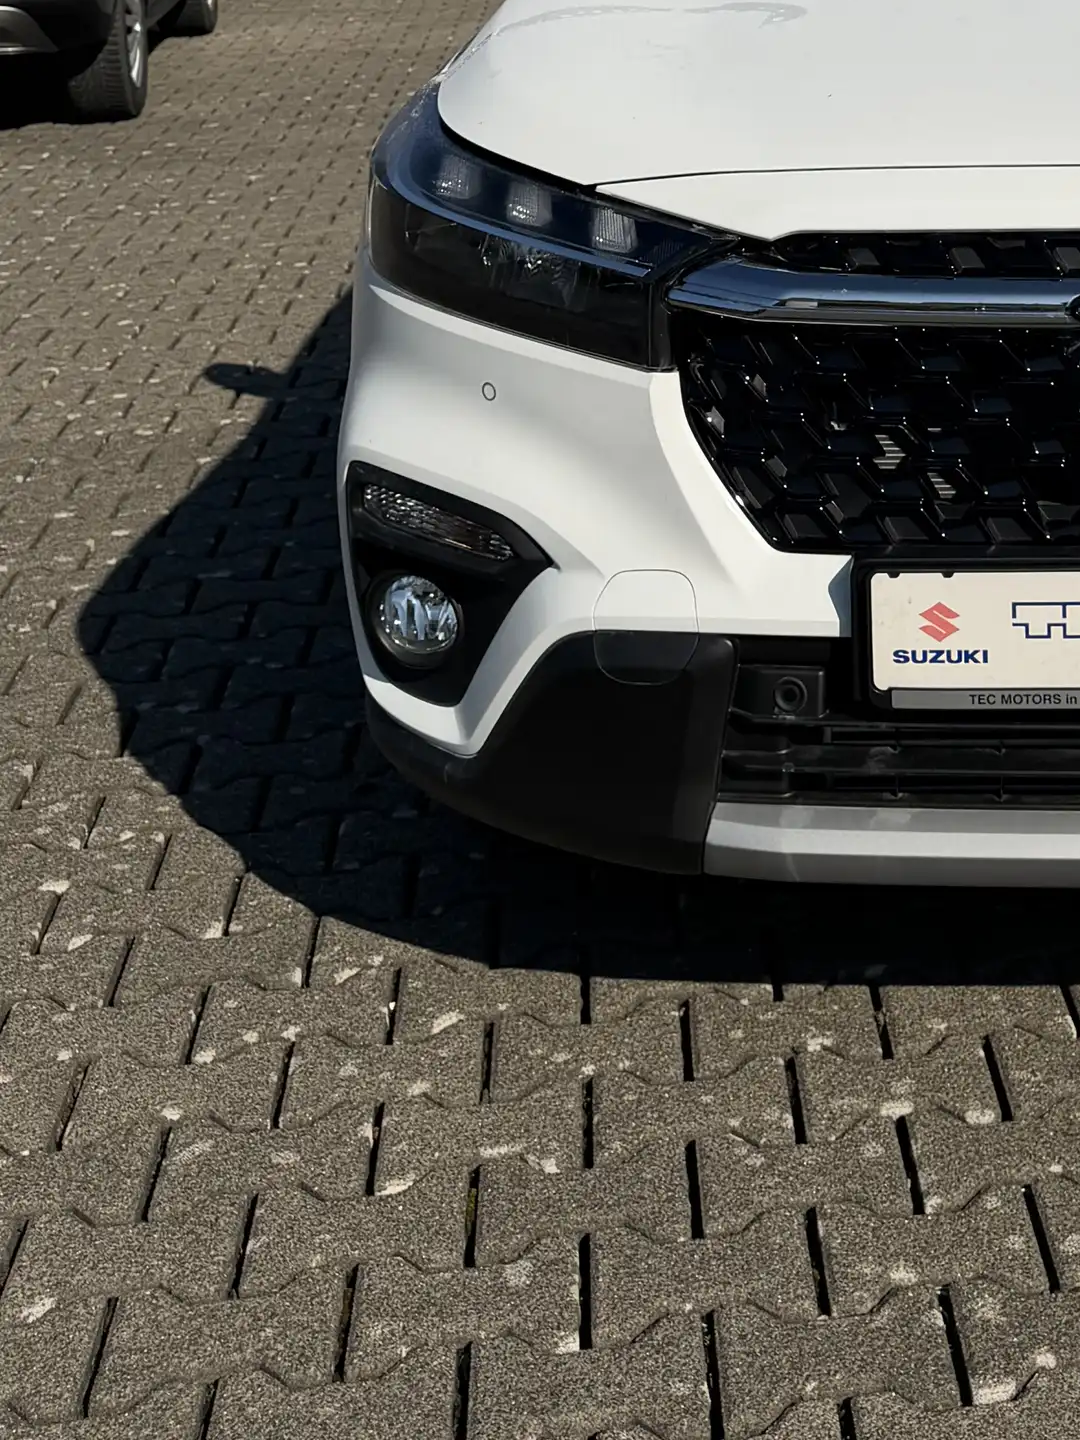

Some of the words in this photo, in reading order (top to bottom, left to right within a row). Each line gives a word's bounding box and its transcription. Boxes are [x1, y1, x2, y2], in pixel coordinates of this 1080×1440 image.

[893, 649, 989, 664] SUZUKI
[969, 694, 996, 706] TEC
[1001, 693, 1062, 706] MOTORS
[1066, 694, 1077, 705] in
